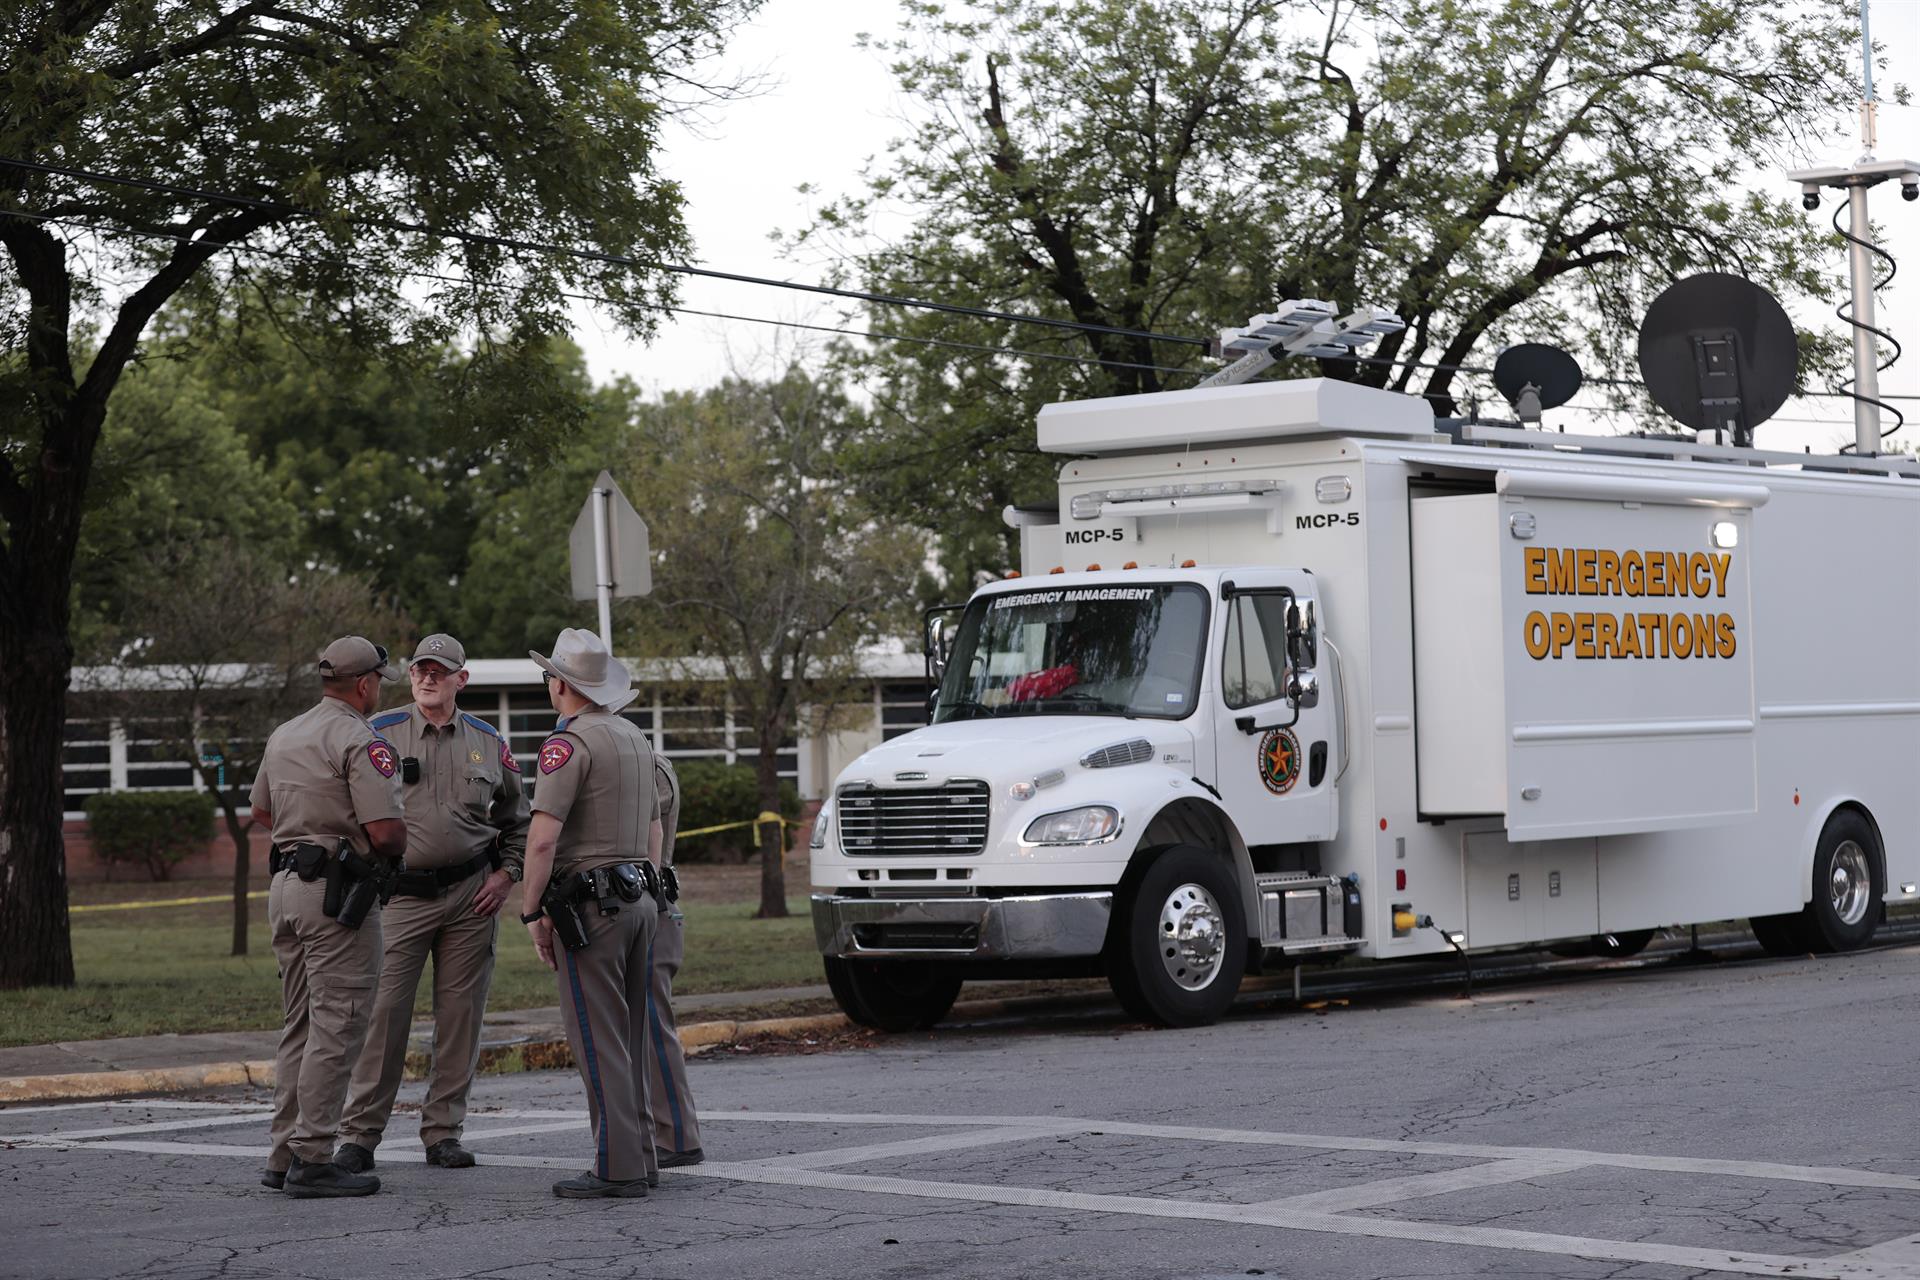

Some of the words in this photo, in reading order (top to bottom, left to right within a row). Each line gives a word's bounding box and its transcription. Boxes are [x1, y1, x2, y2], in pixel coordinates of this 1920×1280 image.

[1295, 512, 1360, 530] MCP-5
[1065, 528, 1124, 544] MCP-5
[1524, 546, 1731, 598] EMERGENCY
[994, 591, 1064, 610] EMERGENCY
[1064, 588, 1155, 602] MANAGEMENT
[1523, 610, 1737, 661] OPERATIONS
